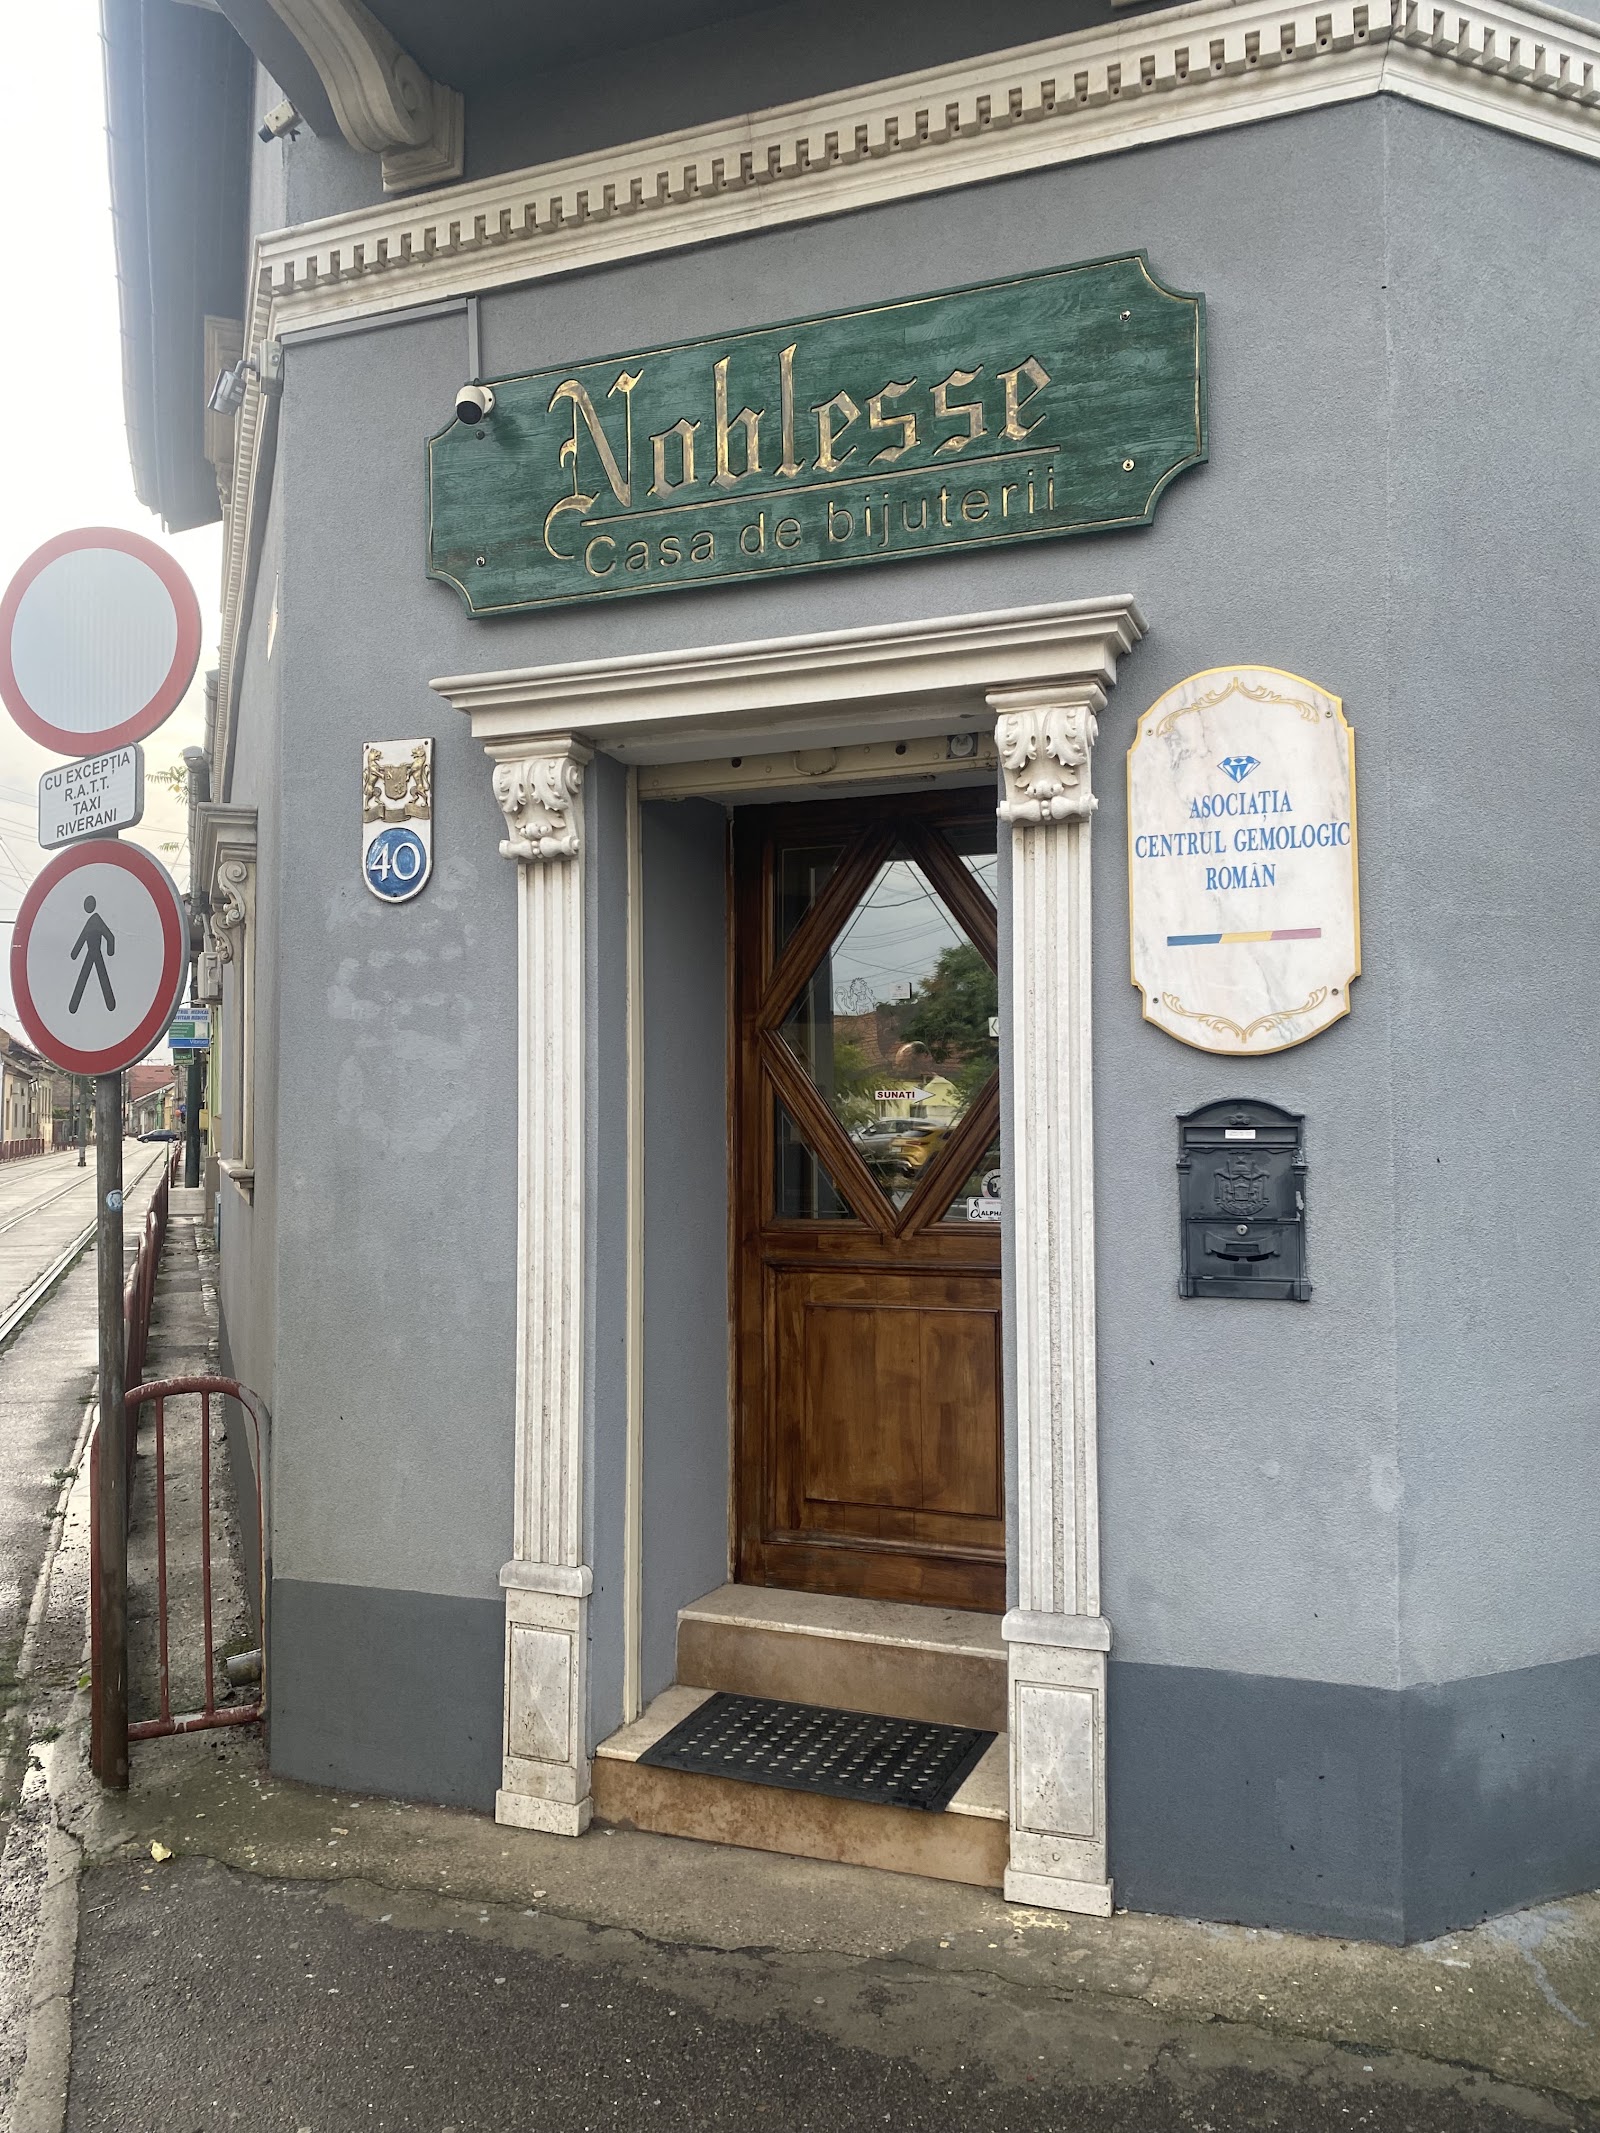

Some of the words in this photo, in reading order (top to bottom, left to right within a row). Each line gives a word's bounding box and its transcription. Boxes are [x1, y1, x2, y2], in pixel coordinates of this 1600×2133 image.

[544, 342, 1052, 561] Noblesse
[584, 531, 717, 577] Casa
[739, 511, 802, 557] de
[827, 466, 1055, 548] bijuterii
[44, 773, 62, 791] CU
[66, 751, 131, 785] EXCEPȚIA
[64, 775, 110, 802] R.A.T.T.
[56, 807, 117, 839] RIVERANI
[72, 795, 101, 816] TAXI
[1188, 789, 1293, 822] ASOCIAȚIA
[1135, 830, 1227, 859] CENTRUL
[1233, 821, 1351, 853] GEMOLOGIC
[369, 842, 421, 881] 40
[1205, 861, 1277, 891] ROMÂN
